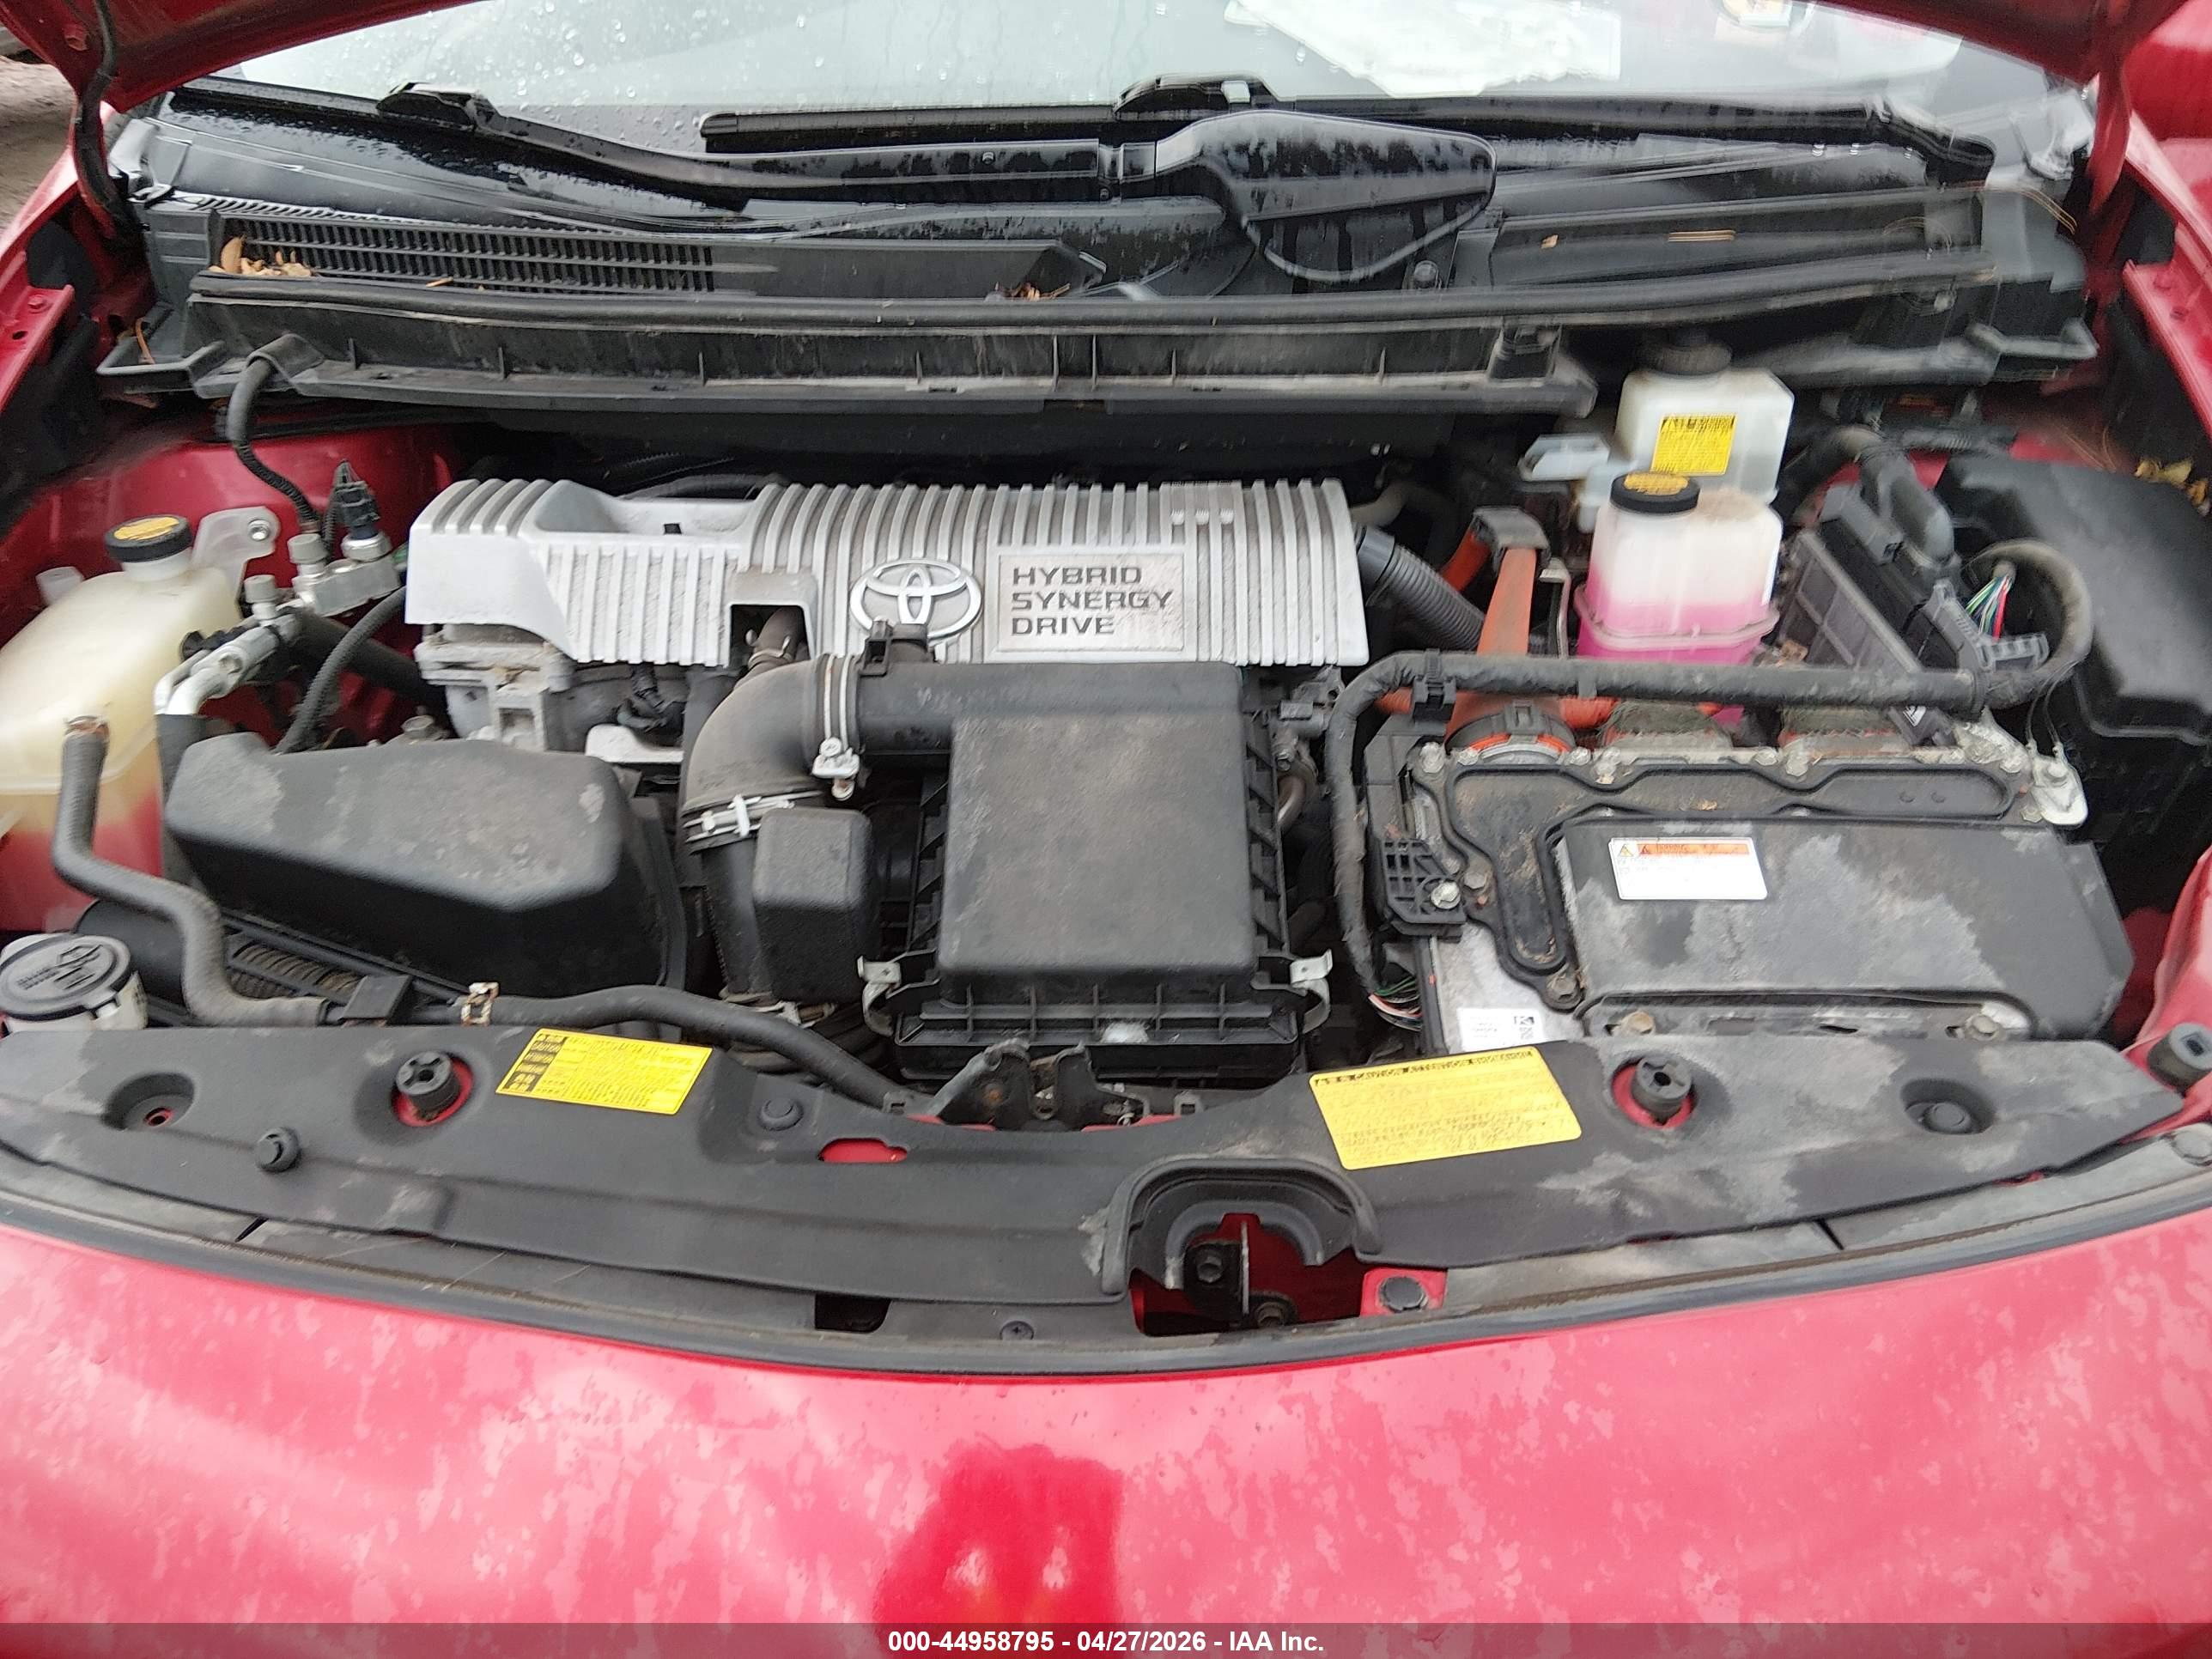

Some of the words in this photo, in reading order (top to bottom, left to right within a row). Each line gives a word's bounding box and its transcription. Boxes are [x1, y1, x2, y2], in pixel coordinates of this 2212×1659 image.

[1012, 567, 1142, 586] HYBRID
[1012, 590, 1173, 611] SYNERGY
[1012, 617, 1115, 635] DRIVE
